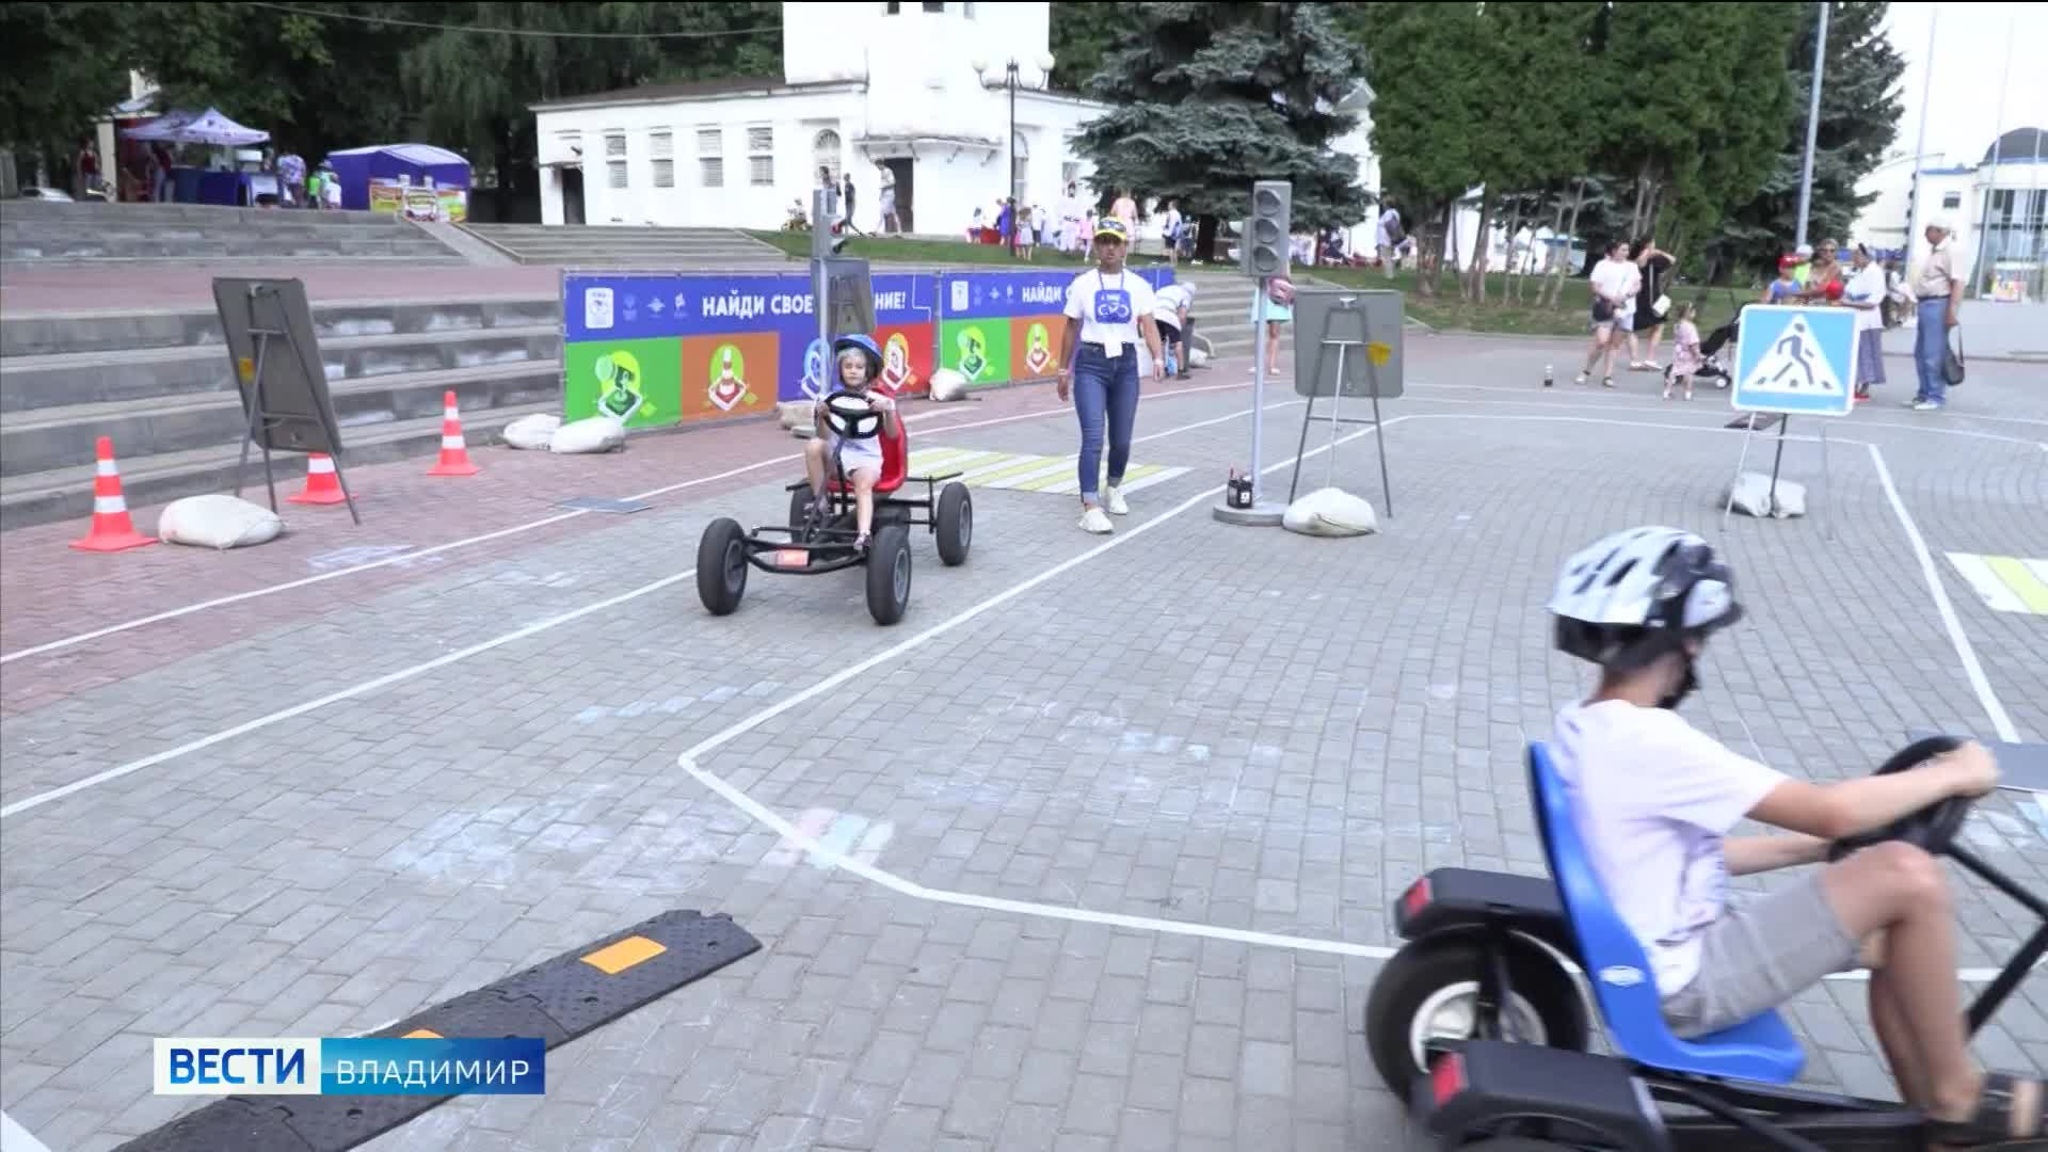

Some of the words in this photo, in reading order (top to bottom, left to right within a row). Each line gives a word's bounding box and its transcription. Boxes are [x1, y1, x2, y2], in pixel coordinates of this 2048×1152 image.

[702, 289, 765, 319] НАЙДИ
[770, 295, 814, 315] СВОЕ
[1022, 281, 1062, 304] НАЙДИ
